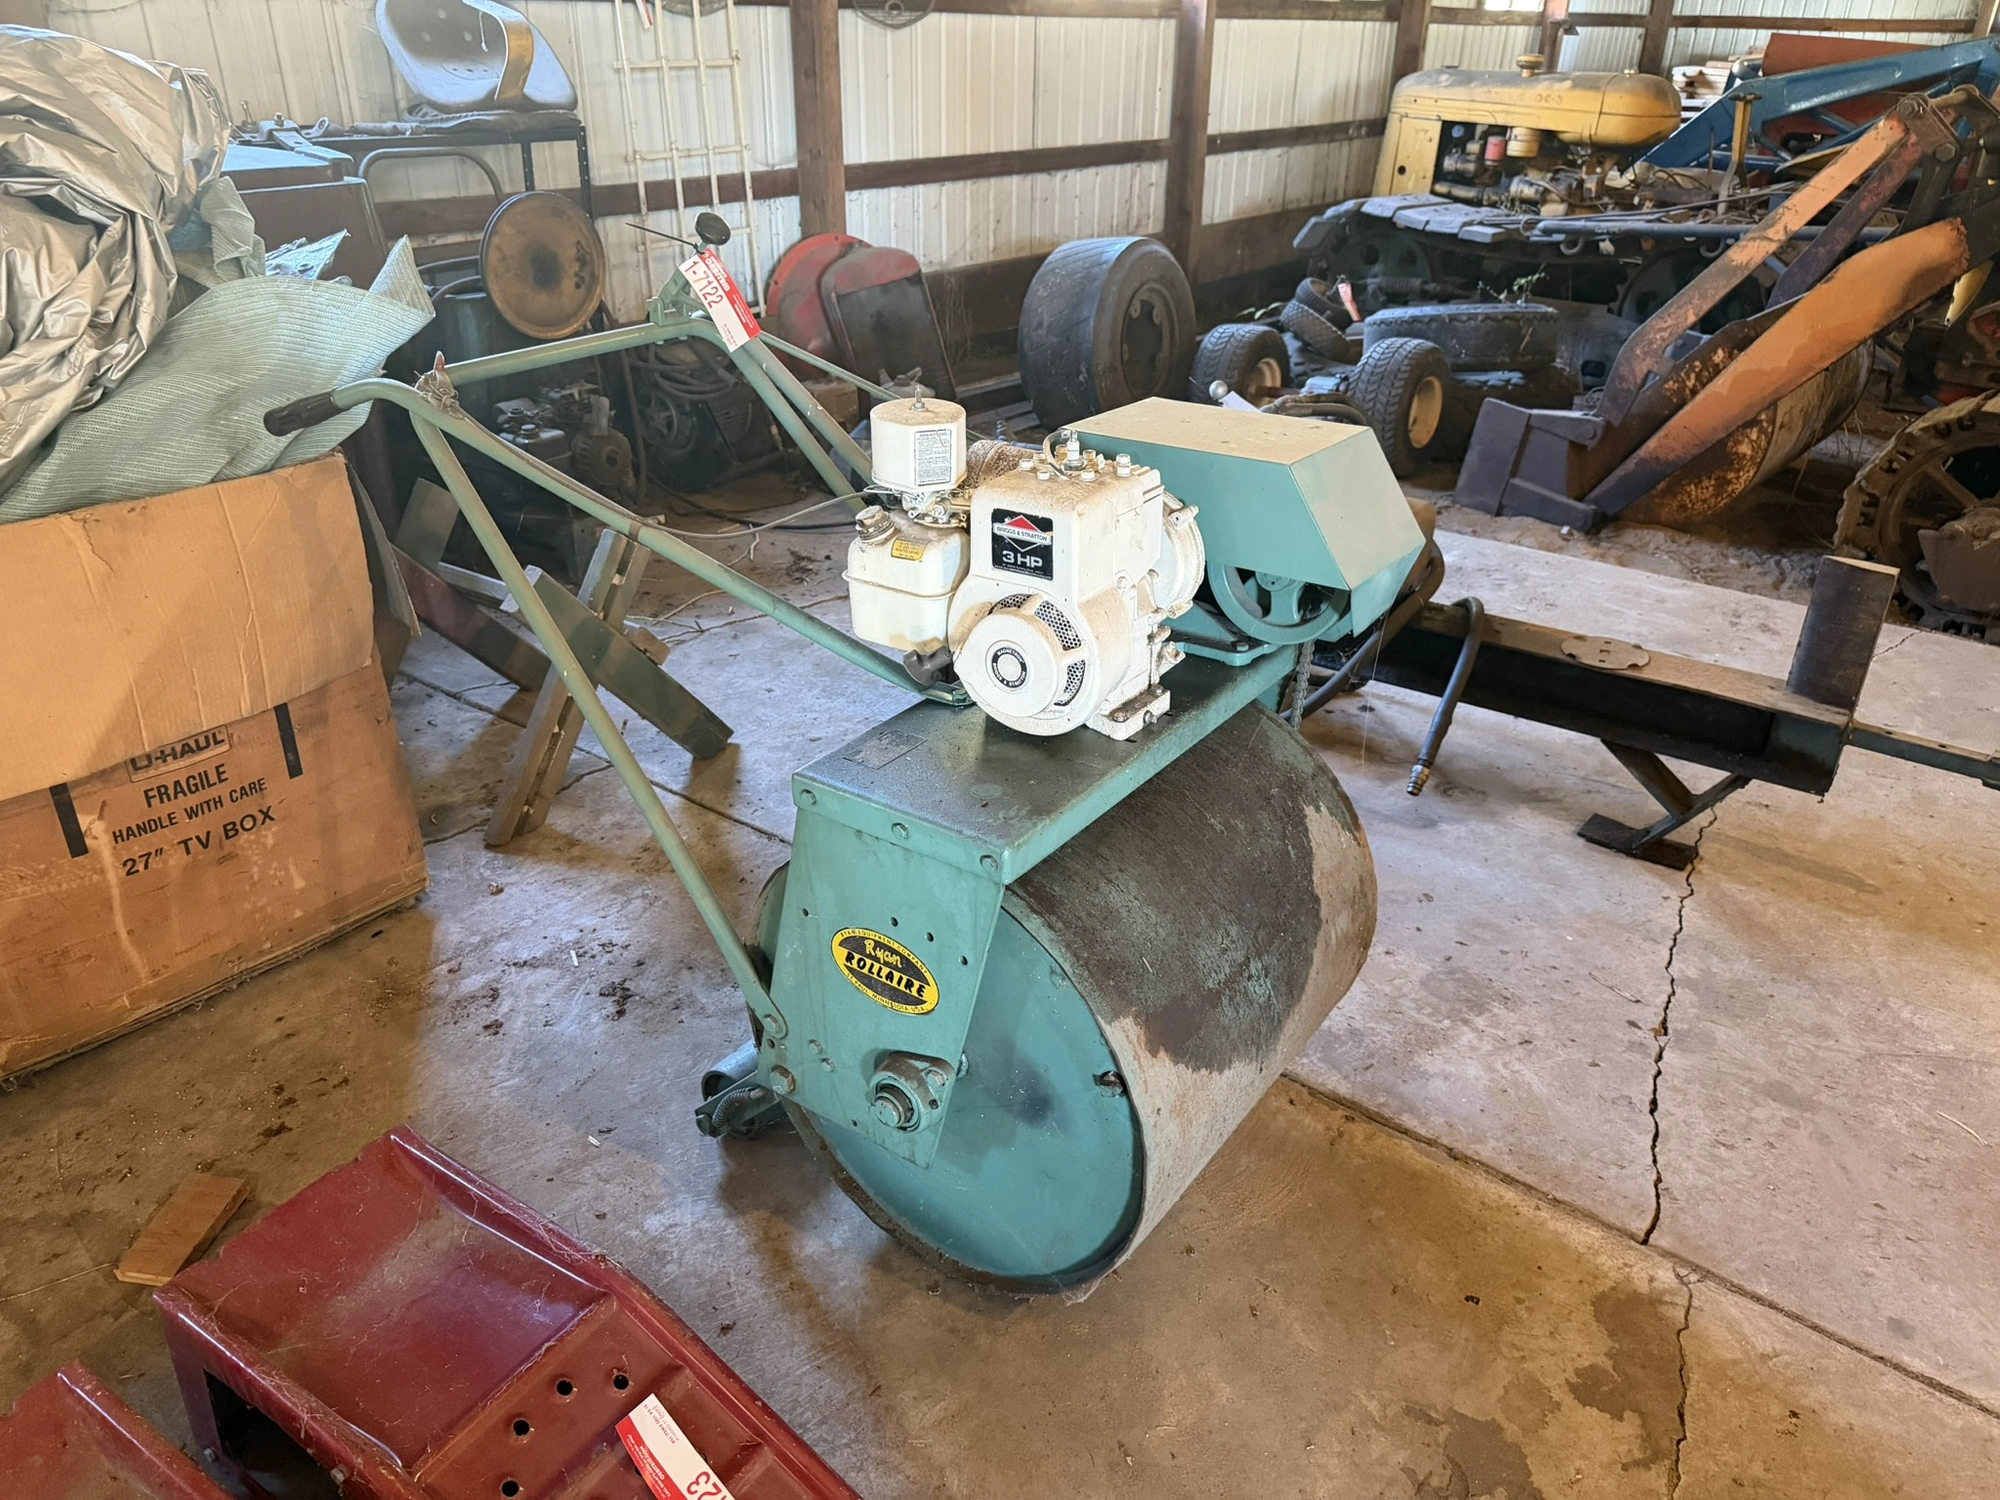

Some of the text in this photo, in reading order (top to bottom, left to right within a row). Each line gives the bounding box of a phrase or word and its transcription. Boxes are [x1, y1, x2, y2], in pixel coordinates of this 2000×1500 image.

[684, 260, 724, 310] 1-7122
[996, 525, 1017, 536] BRIGGS
[1021, 531, 1048, 542] STRATTON
[1002, 550, 1043, 568] 3 HP
[129, 731, 226, 772] U-HAUL
[143, 763, 229, 808] FRAGILE
[112, 777, 268, 844] HANDLE WITH CARE
[122, 805, 276, 877] 27" TV BOX
[864, 939, 903, 968] Ryan
[896, 945, 928, 974] COMPANY
[844, 951, 926, 998] ROLLAIRE
[658, 1424, 670, 1437] ITEMS
